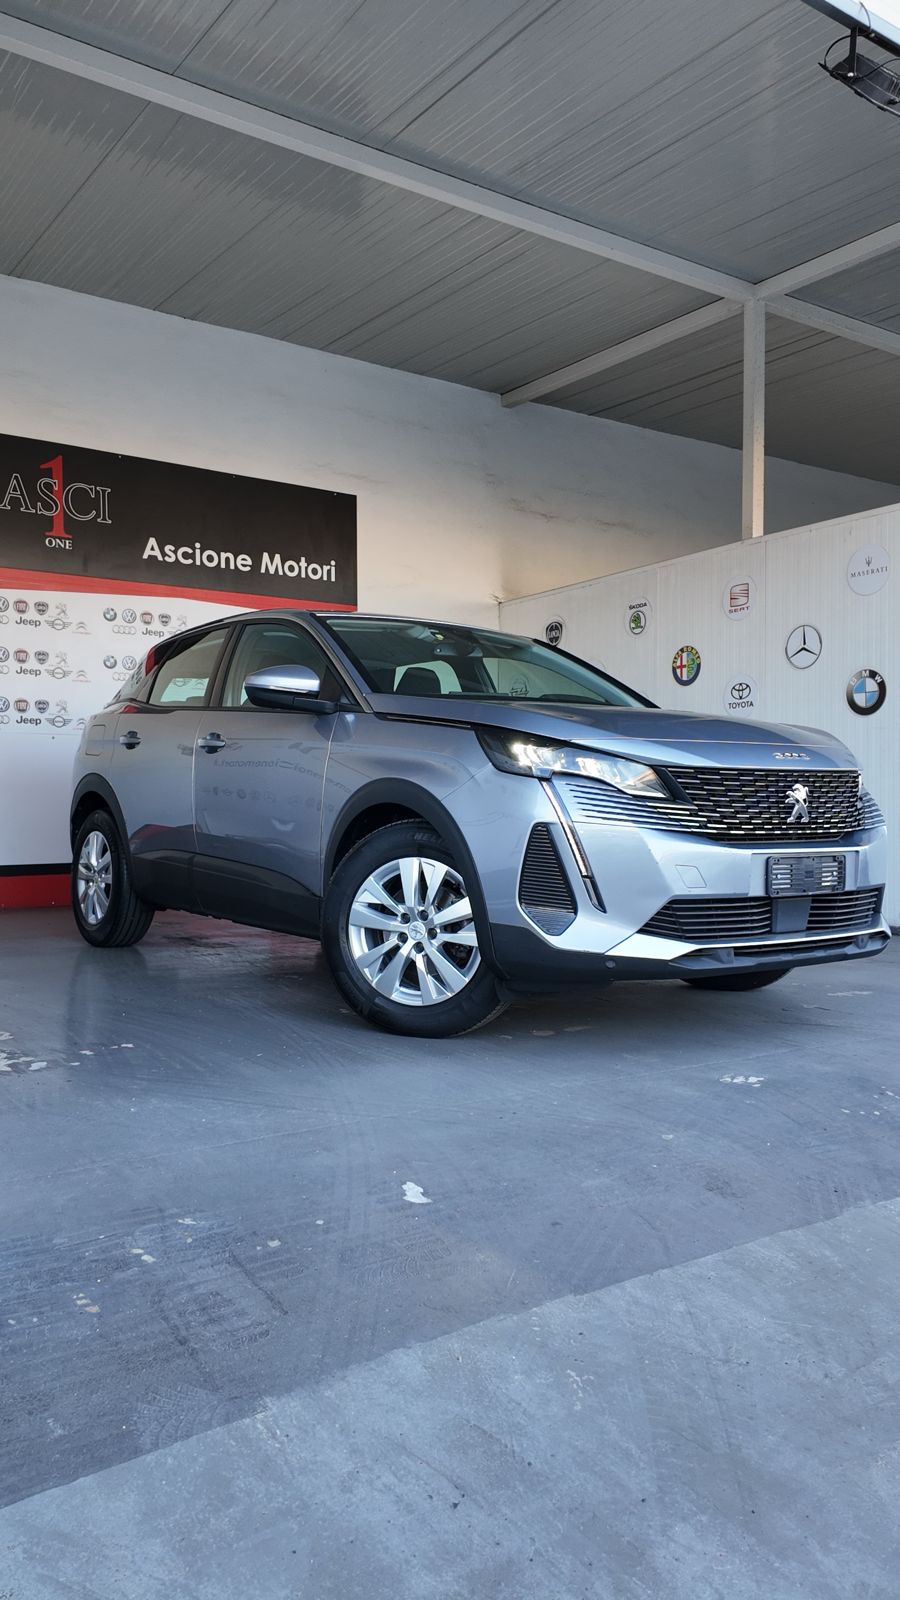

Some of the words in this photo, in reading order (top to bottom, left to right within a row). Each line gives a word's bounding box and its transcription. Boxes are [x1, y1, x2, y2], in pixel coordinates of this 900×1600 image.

[45, 537, 73, 550] ONE
[142, 537, 253, 572] Ascione
[260, 551, 336, 582] Motori
[850, 566, 888, 578] MASERATI
[728, 606, 751, 614] SEAT
[15, 616, 41, 627] Jeep
[142, 627, 164, 638] Jeep
[15, 665, 42, 677] Jeep
[728, 700, 754, 710] TOYOTA
[15, 715, 42, 726] Jeep
